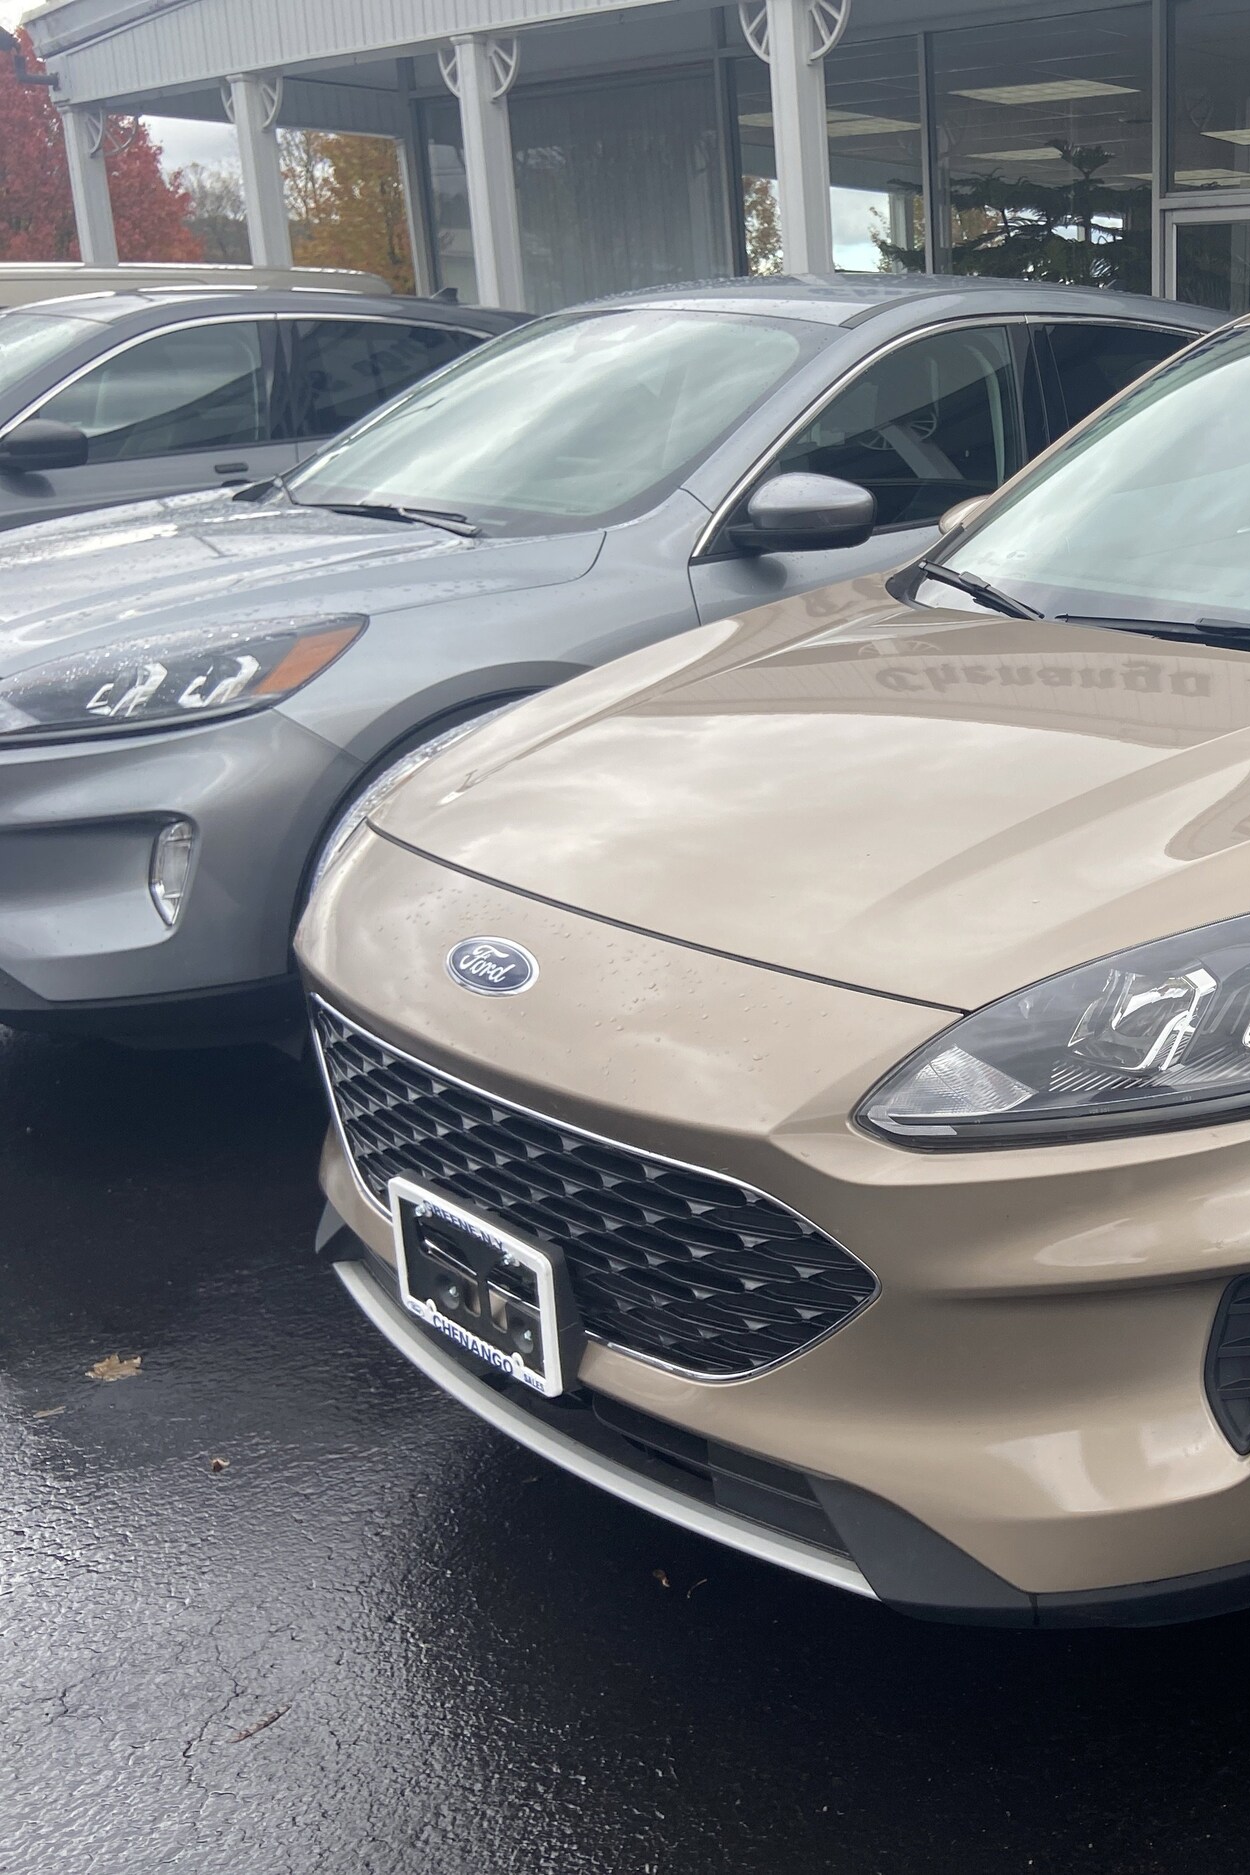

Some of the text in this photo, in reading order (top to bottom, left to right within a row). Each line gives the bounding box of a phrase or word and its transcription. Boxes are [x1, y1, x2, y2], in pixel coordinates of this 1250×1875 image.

[459, 944, 515, 984] Ford
[432, 1314, 545, 1392] CHENANGO SALES
